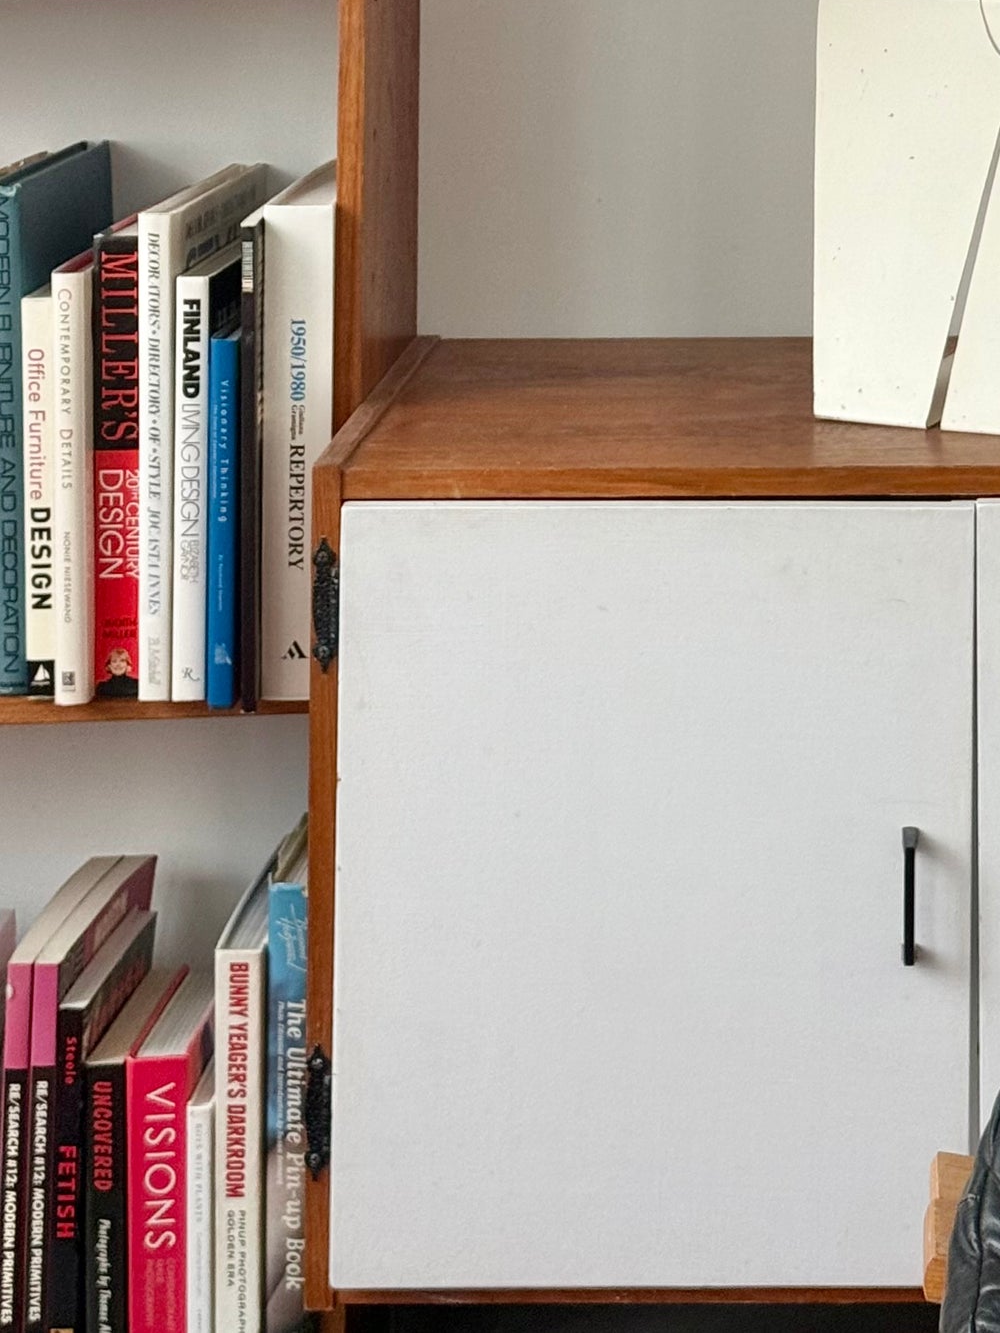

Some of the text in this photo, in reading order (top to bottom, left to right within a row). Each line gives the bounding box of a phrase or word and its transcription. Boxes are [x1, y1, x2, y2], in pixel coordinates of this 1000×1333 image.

[57, 288, 74, 490] CONTEMPORARY DETAILS
[101, 251, 138, 441] MILLER'S
[147, 337, 161, 417] DIRECTORY
[289, 317, 308, 402] 1950/1980
[148, 426, 161, 447] OF
[181, 298, 201, 538] FINLAND LIVING DESIGN
[217, 380, 229, 523] Visionary Thinking
[28, 349, 52, 610] Office Furniture DESIGN
[99, 469, 124, 579] DESIGN
[148, 454, 161, 500] STYLE
[288, 444, 305, 571] REPERTORY
[0, 458, 19, 674] AND DECORATION
[63, 531, 72, 623] NONIE NIESEWAND
[124, 498, 139, 580] CENTURY
[286, 999, 306, 1039] The
[225, 961, 249, 1199] BUNNY YEAGER'S DARKROOM
[286, 1047, 306, 1144] Ultimate
[92, 1081, 113, 1192] UNCOVERED
[144, 1082, 177, 1251] VISIONS
[0, 1083, 21, 1324] RE/SEARCH MODERN PRIMITIVES
[28, 1080, 49, 1322] RE/SEARCH MODERN PRIMITIVES
[56, 1145, 77, 1239] FETISH
[238, 1209, 247, 1246] PINUP
[281, 1151, 307, 1230] Pin-up
[226, 1209, 236, 1287] GOLDEN ERA
[286, 1237, 305, 1291] Book
